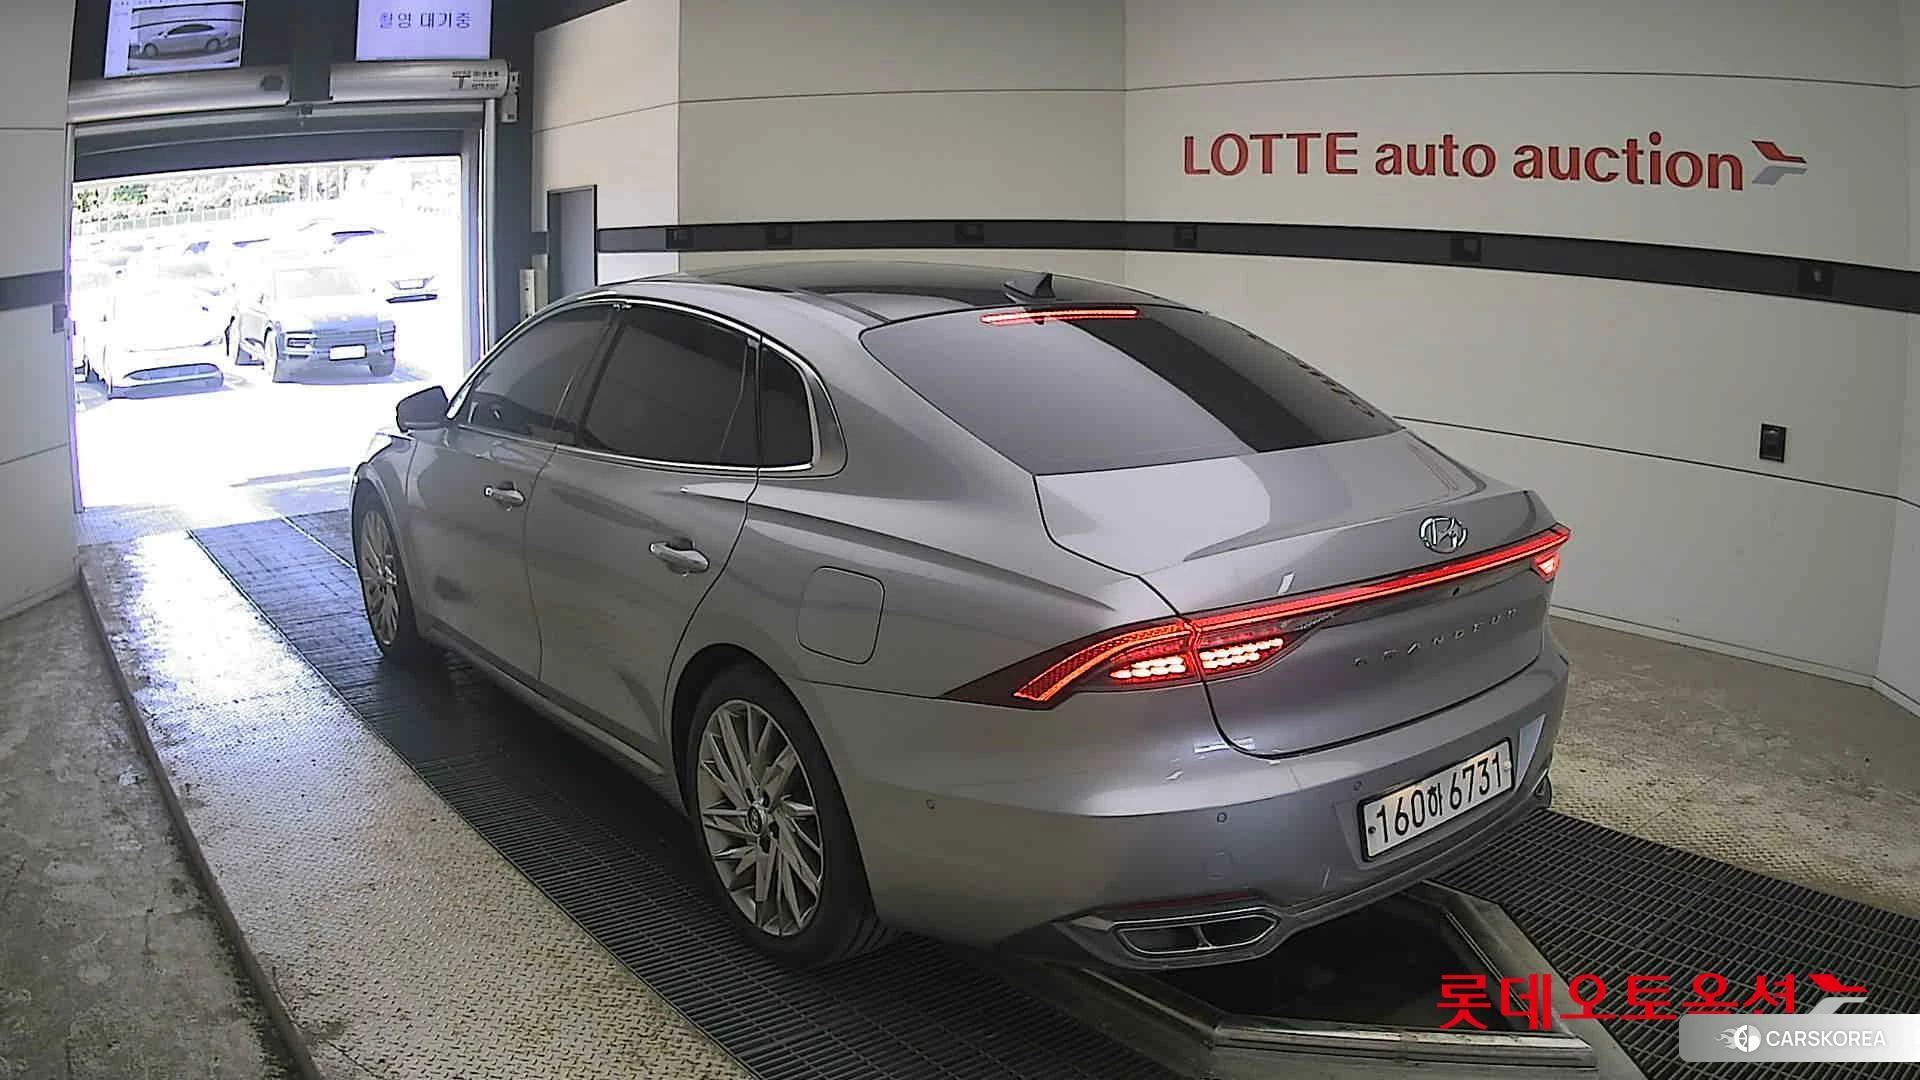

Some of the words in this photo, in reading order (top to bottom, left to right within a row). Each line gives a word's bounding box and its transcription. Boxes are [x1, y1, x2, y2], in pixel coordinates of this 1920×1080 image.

[420, 12, 472, 29] 대기중
[1183, 132, 1359, 177] LOTTE
[1375, 134, 1497, 178] auto
[1513, 131, 1745, 191] auction
